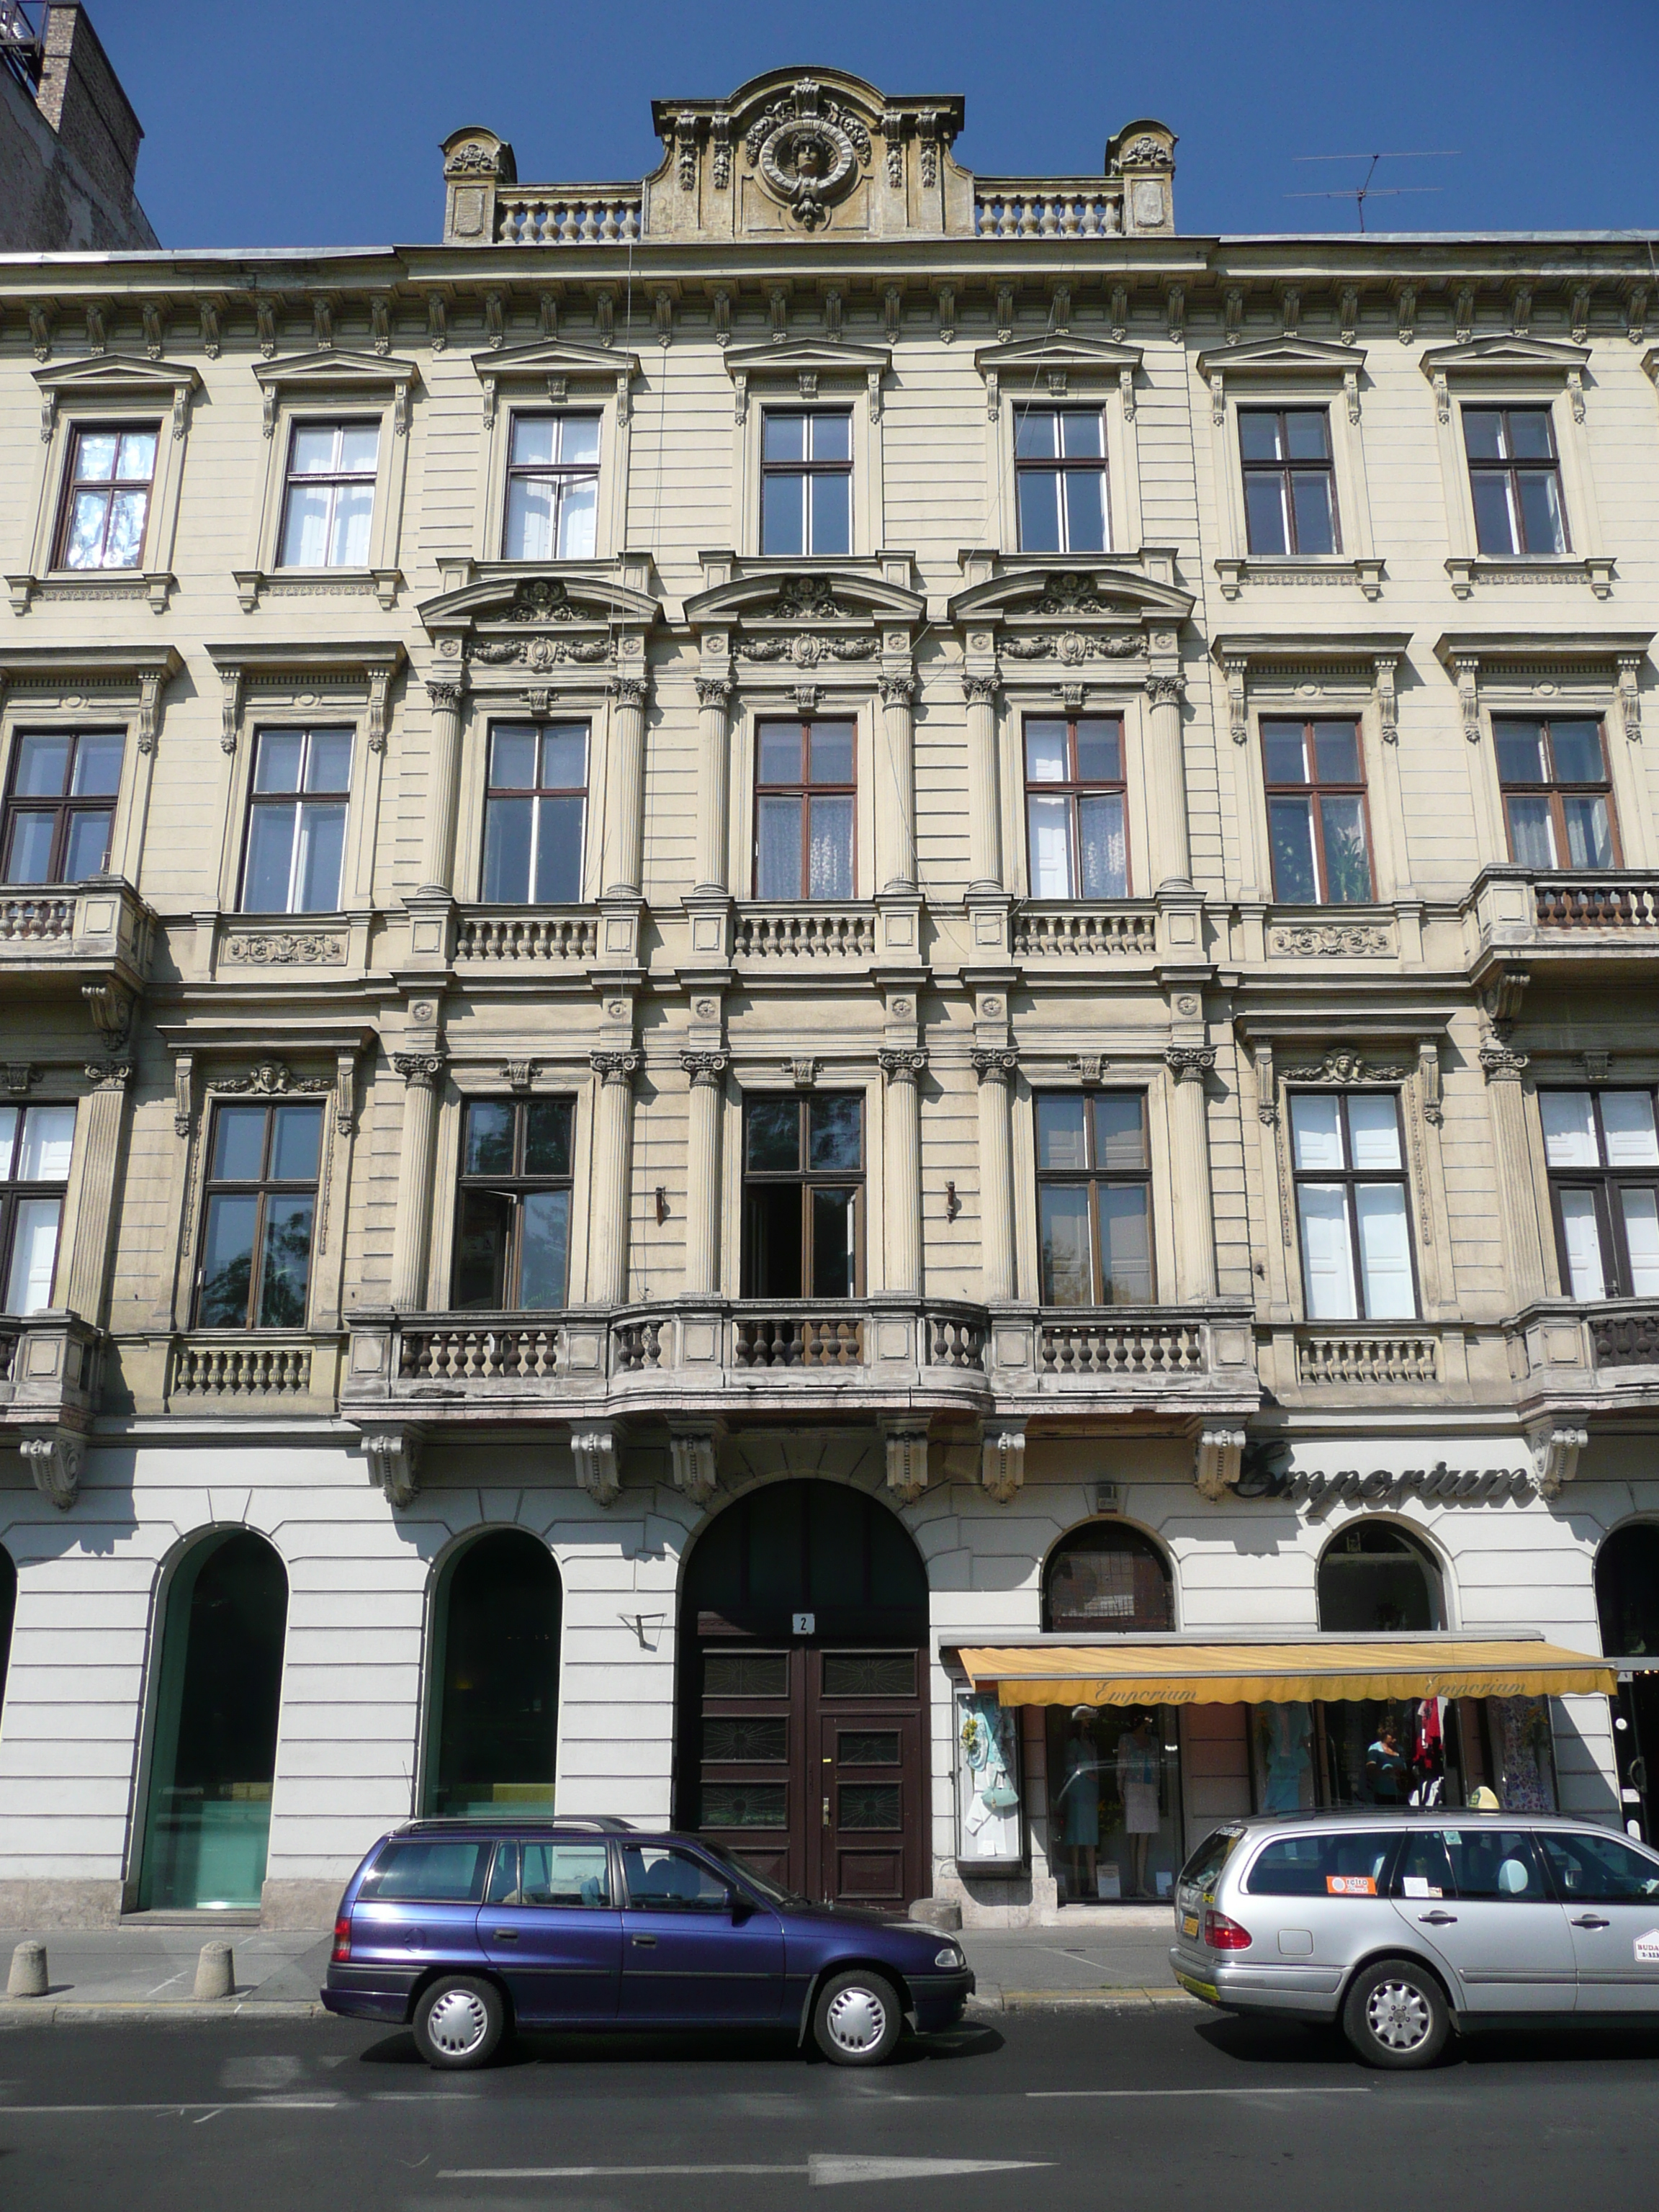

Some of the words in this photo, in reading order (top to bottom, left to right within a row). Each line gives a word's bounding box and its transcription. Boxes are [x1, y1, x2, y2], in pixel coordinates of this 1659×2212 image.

[1230, 1441, 1528, 1515] Emporium
[800, 1617, 806, 1631] 2
[1094, 1680, 1197, 1704] Emporium
[1425, 1673, 1527, 1697] Emporium
